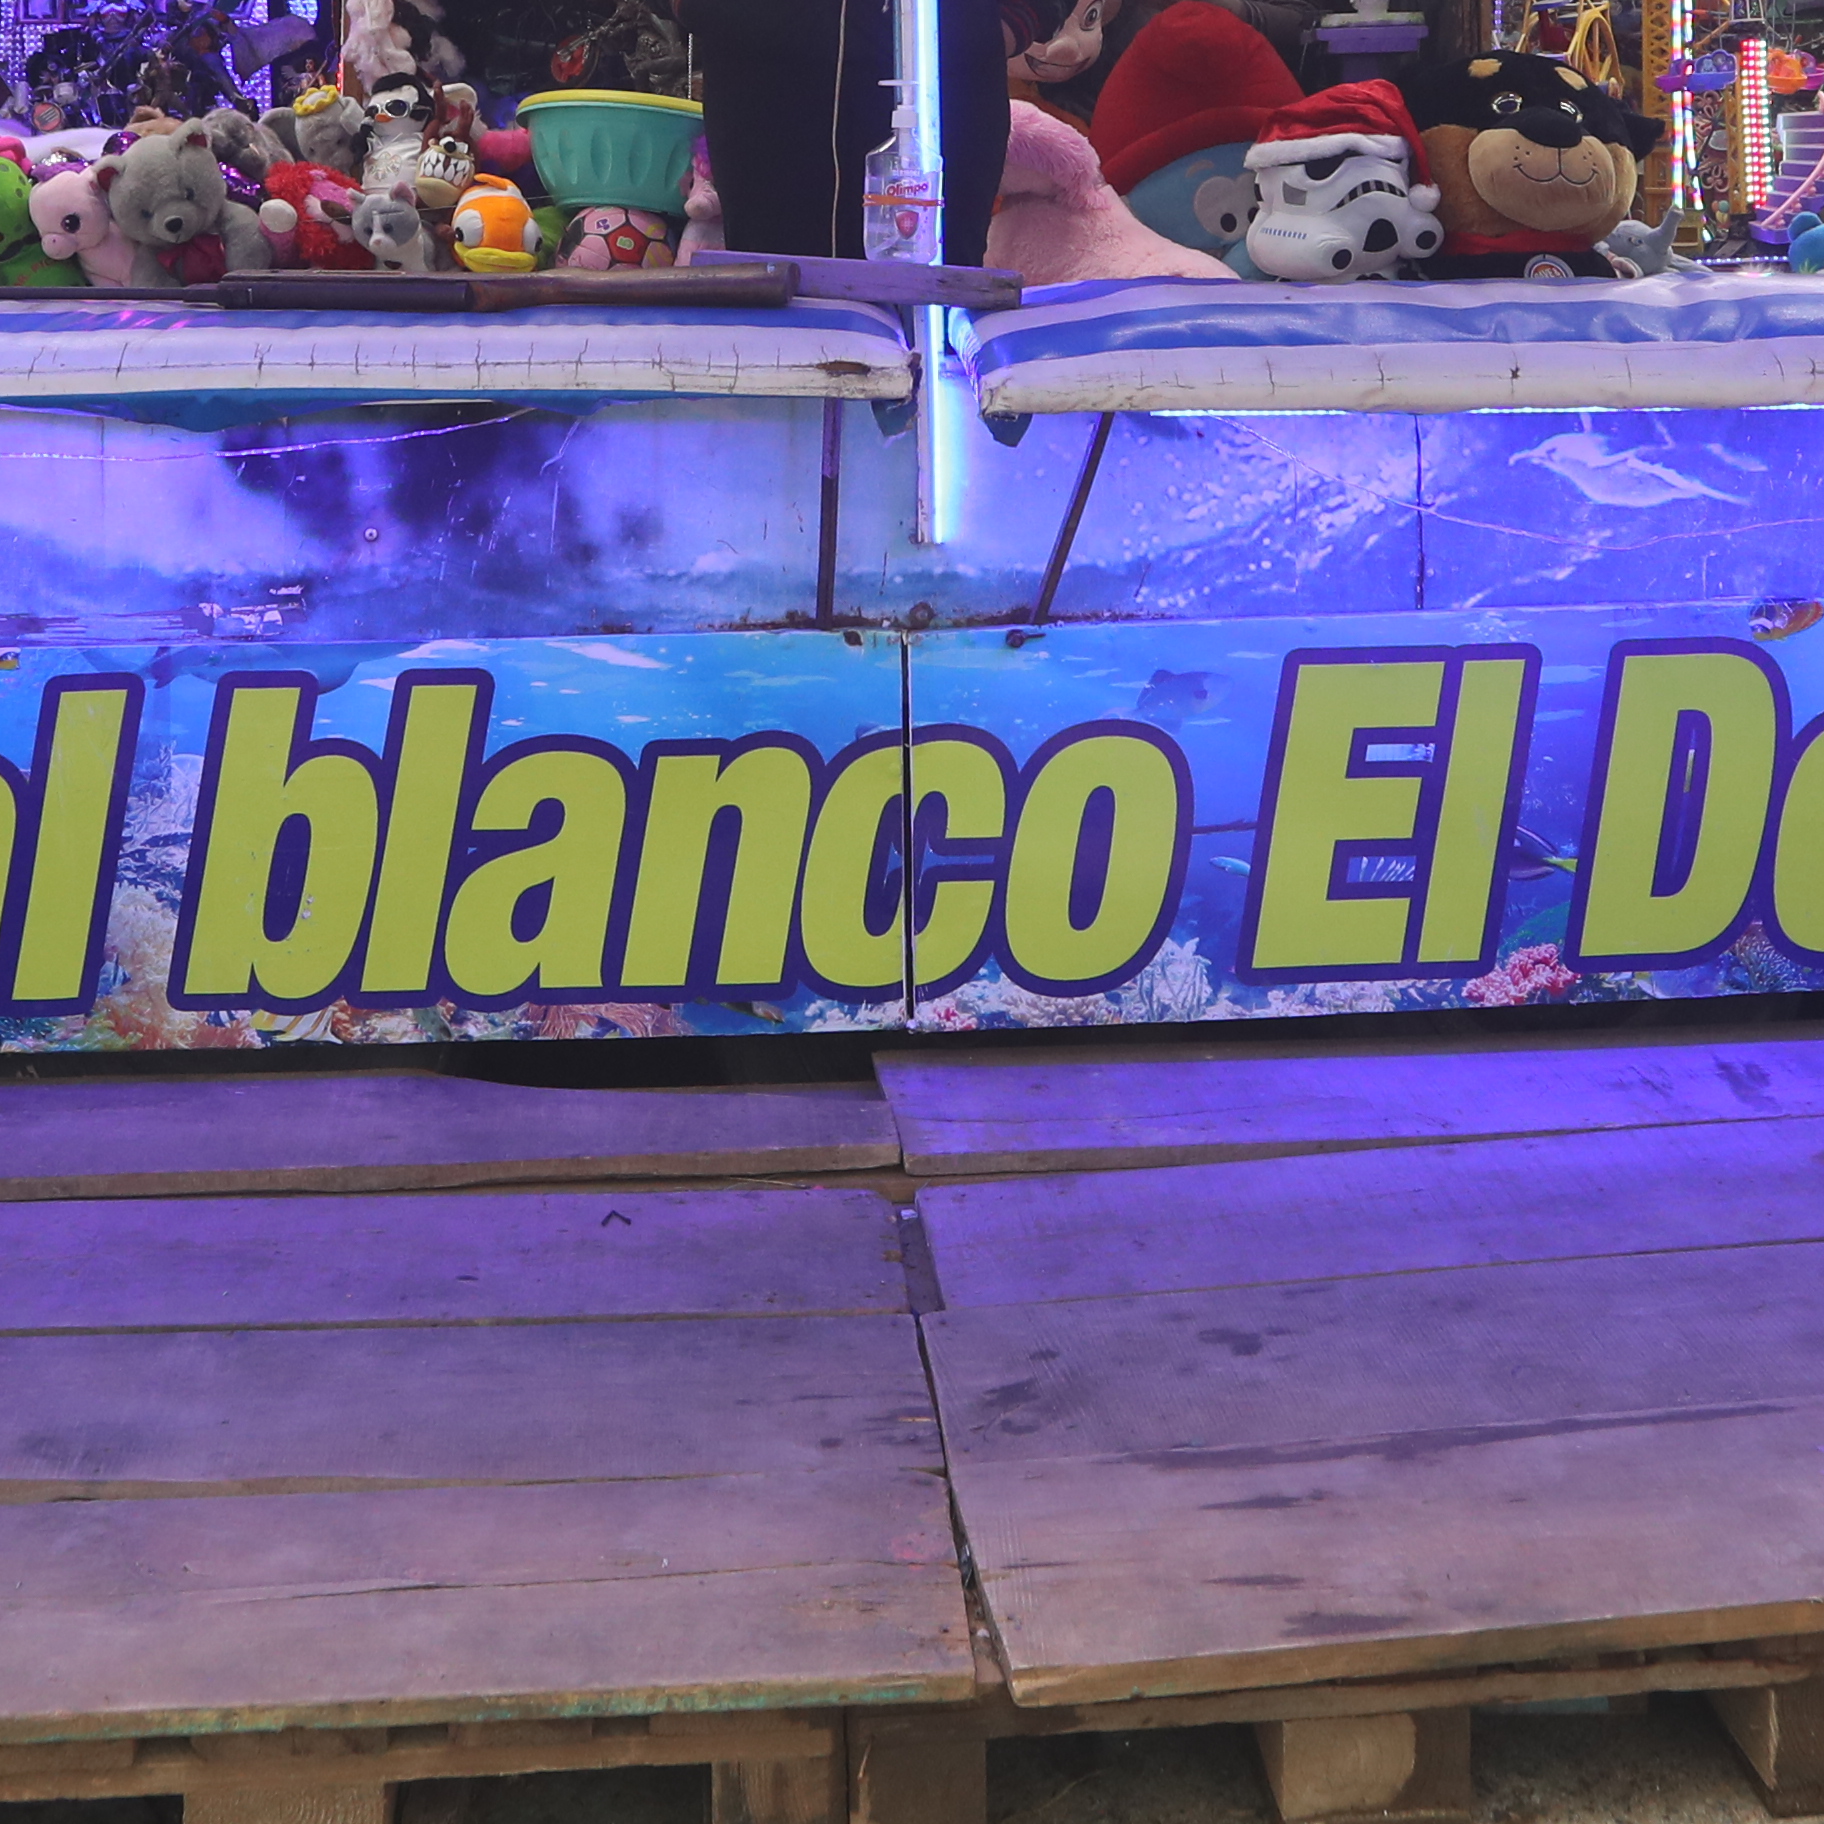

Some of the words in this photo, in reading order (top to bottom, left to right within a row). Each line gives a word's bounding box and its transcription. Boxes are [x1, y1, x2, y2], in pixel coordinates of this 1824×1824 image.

[886, 181, 929, 197] Olimpo
[174, 680, 1176, 1004] blanco
[1246, 652, 1528, 972] El
